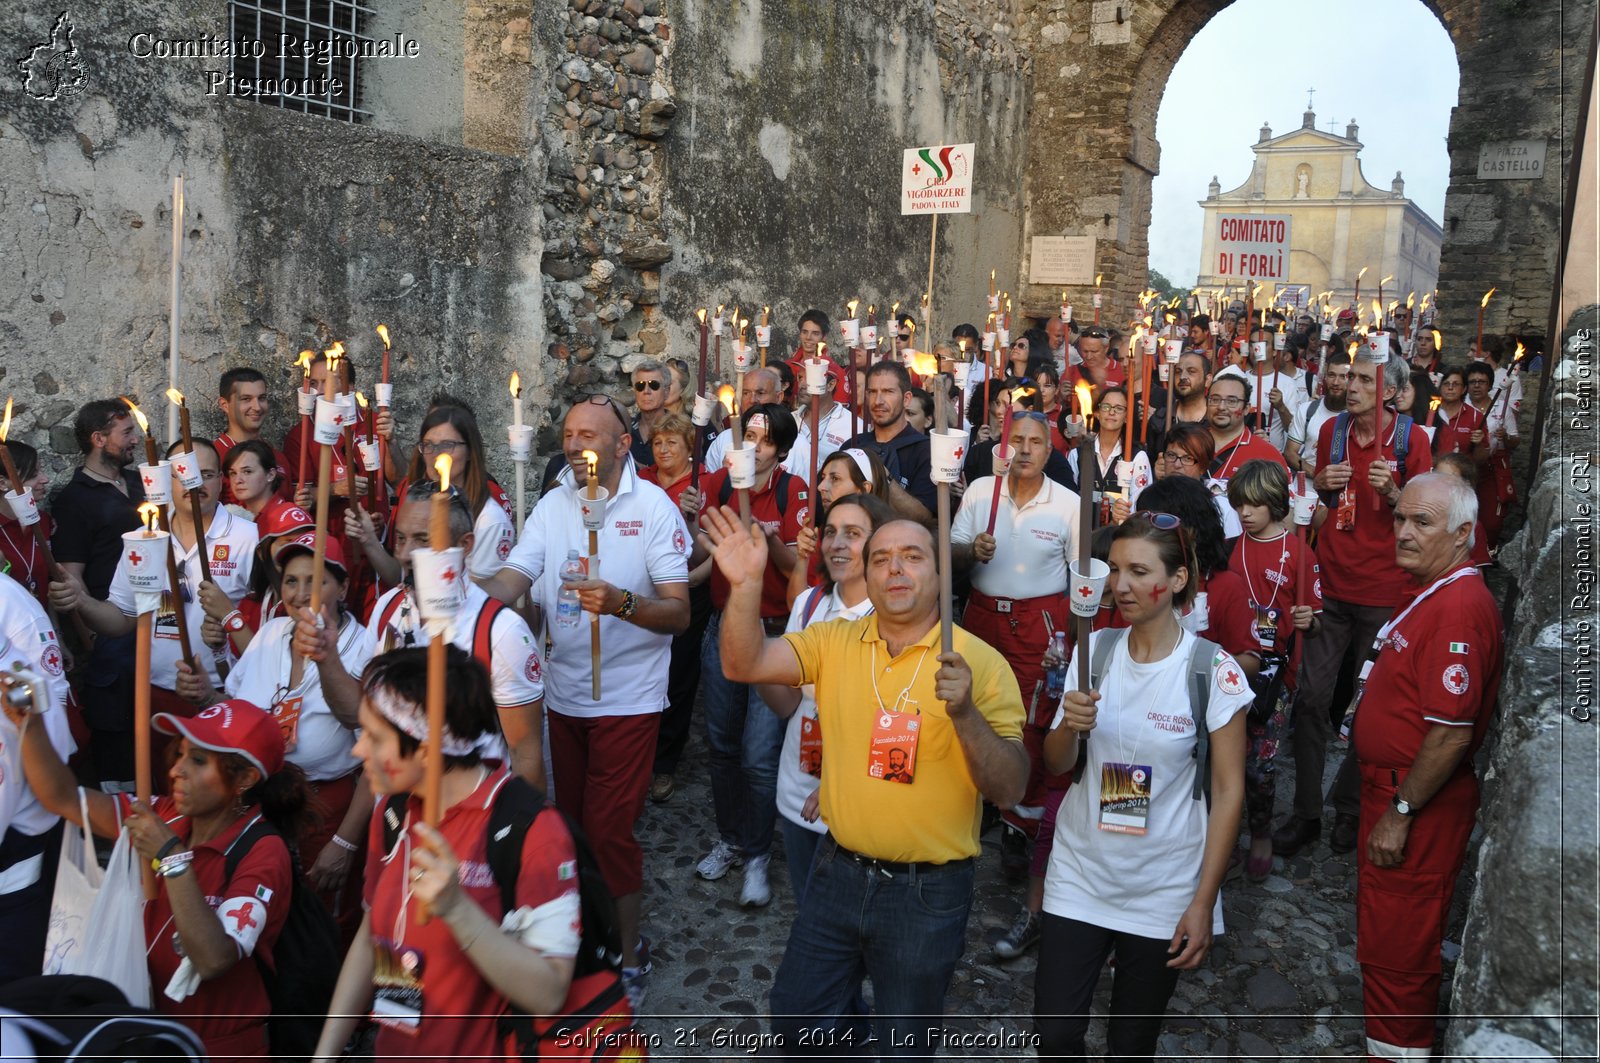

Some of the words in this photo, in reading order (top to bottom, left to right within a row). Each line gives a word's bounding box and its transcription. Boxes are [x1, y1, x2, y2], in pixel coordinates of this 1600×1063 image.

[1497, 147, 1528, 156] PIAZZA
[1482, 160, 1539, 172] CASTELLO
[907, 187, 966, 199] VIGODARZERE
[911, 202, 937, 210] PADOVA
[941, 200, 961, 209] ITALY
[1221, 218, 1285, 244] COMITATO
[1219, 252, 1234, 275] DI
[1240, 248, 1283, 278] FORLÌ
[1147, 712, 1171, 722] CROCE
[1172, 715, 1194, 726] ROSSA
[1154, 722, 1185, 733] ITALIANA
[896, 735, 915, 743] 2014
[1127, 799, 1148, 807] 2014
